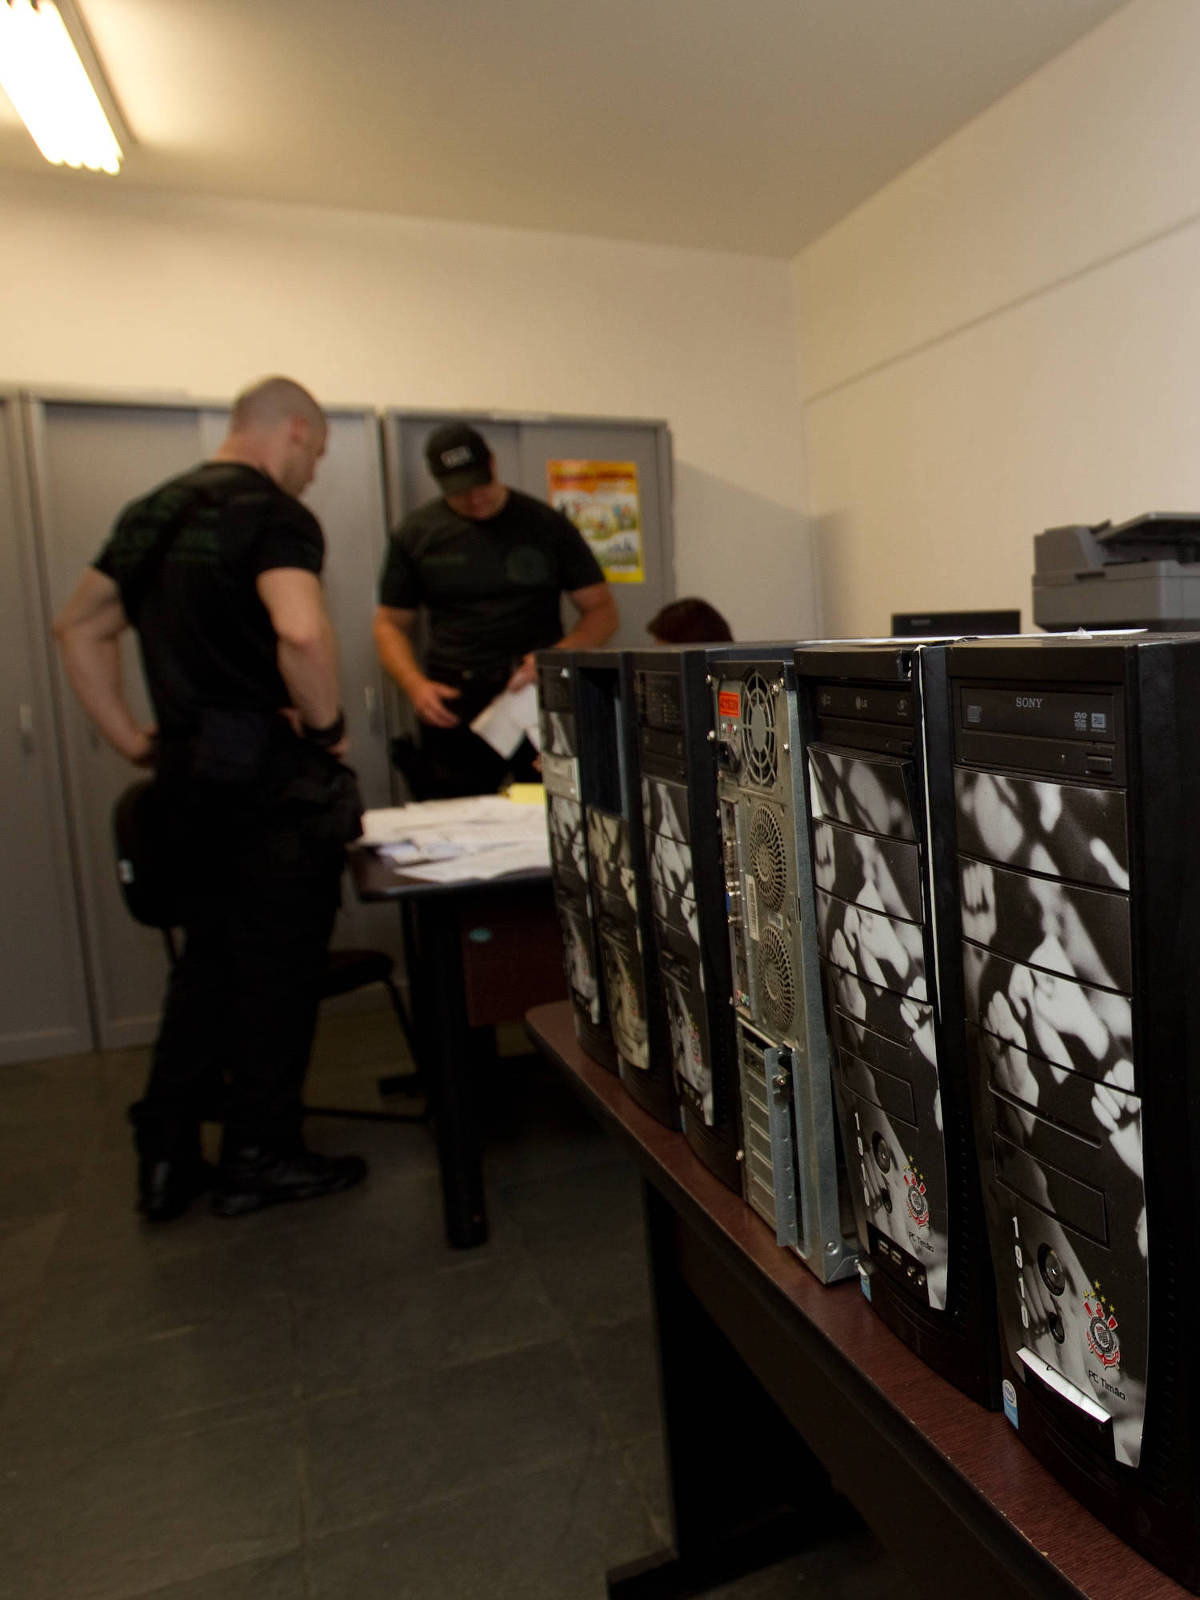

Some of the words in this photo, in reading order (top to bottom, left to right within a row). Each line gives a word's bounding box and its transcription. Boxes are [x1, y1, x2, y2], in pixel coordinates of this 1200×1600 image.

[1016, 698, 1042, 708] SONY
[1012, 1216, 1029, 1329] 1910
[1088, 1369, 1099, 1384] PC
[1100, 1377, 1126, 1401] Timão
